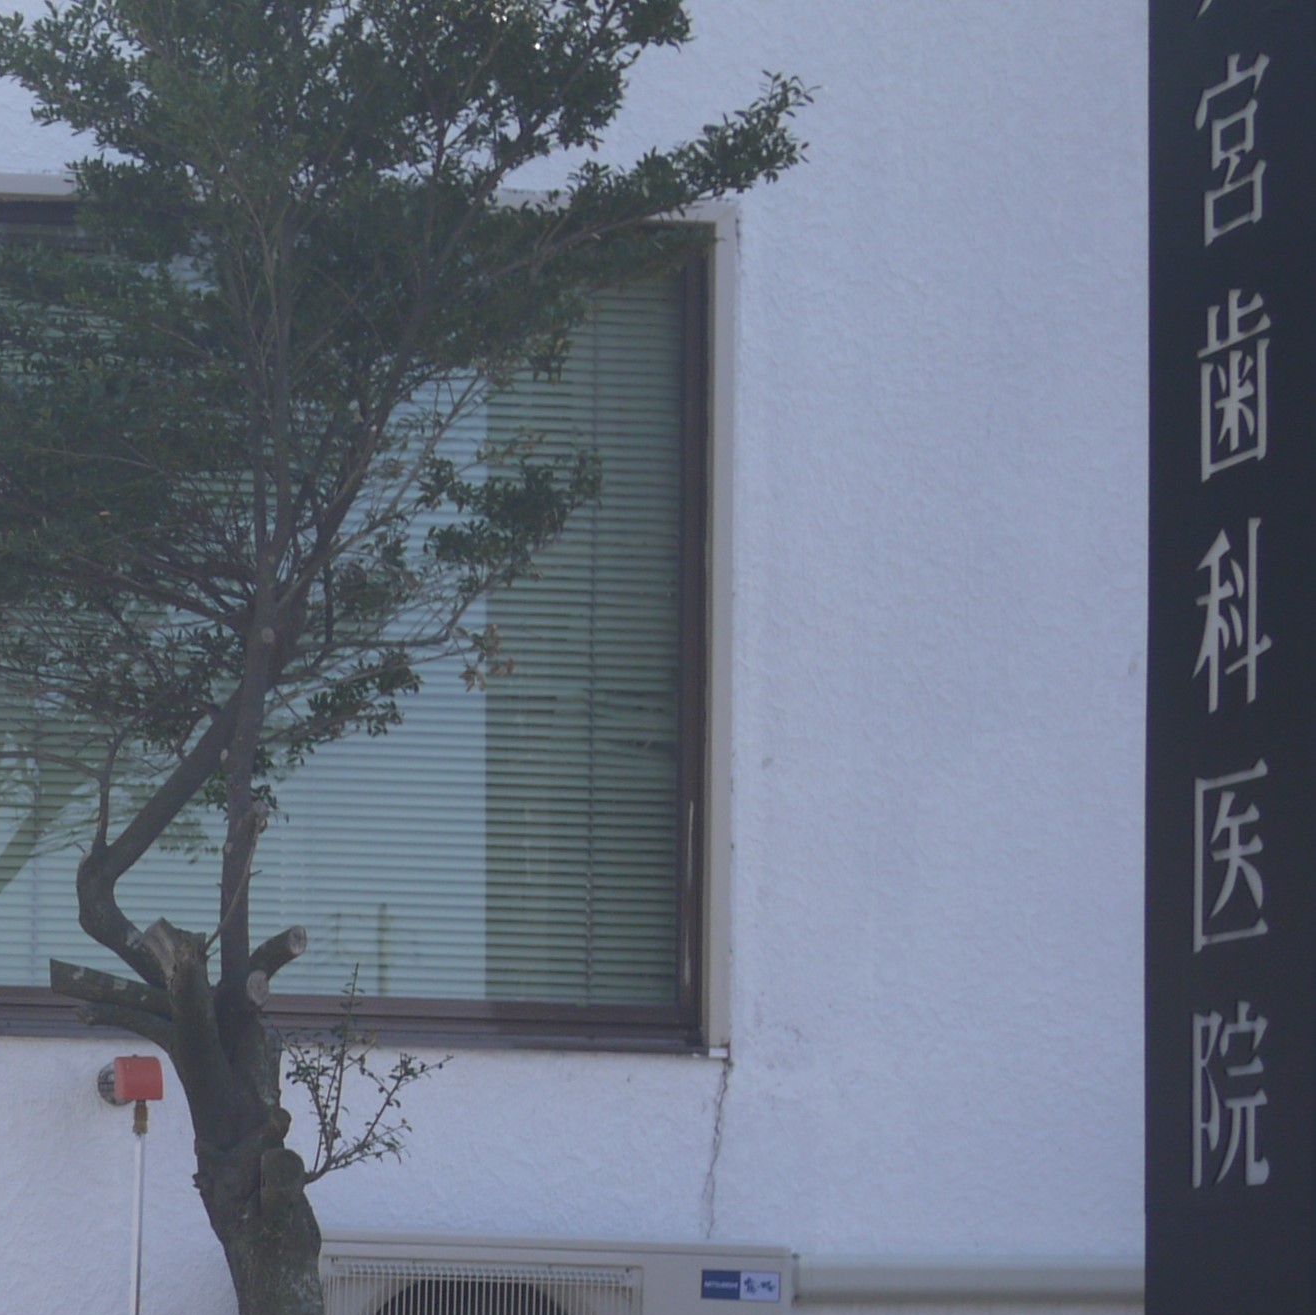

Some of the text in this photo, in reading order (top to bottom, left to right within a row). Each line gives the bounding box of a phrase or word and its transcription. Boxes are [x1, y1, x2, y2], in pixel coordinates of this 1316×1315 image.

[1190, 0, 1271, 1189] 宮歯科医院
